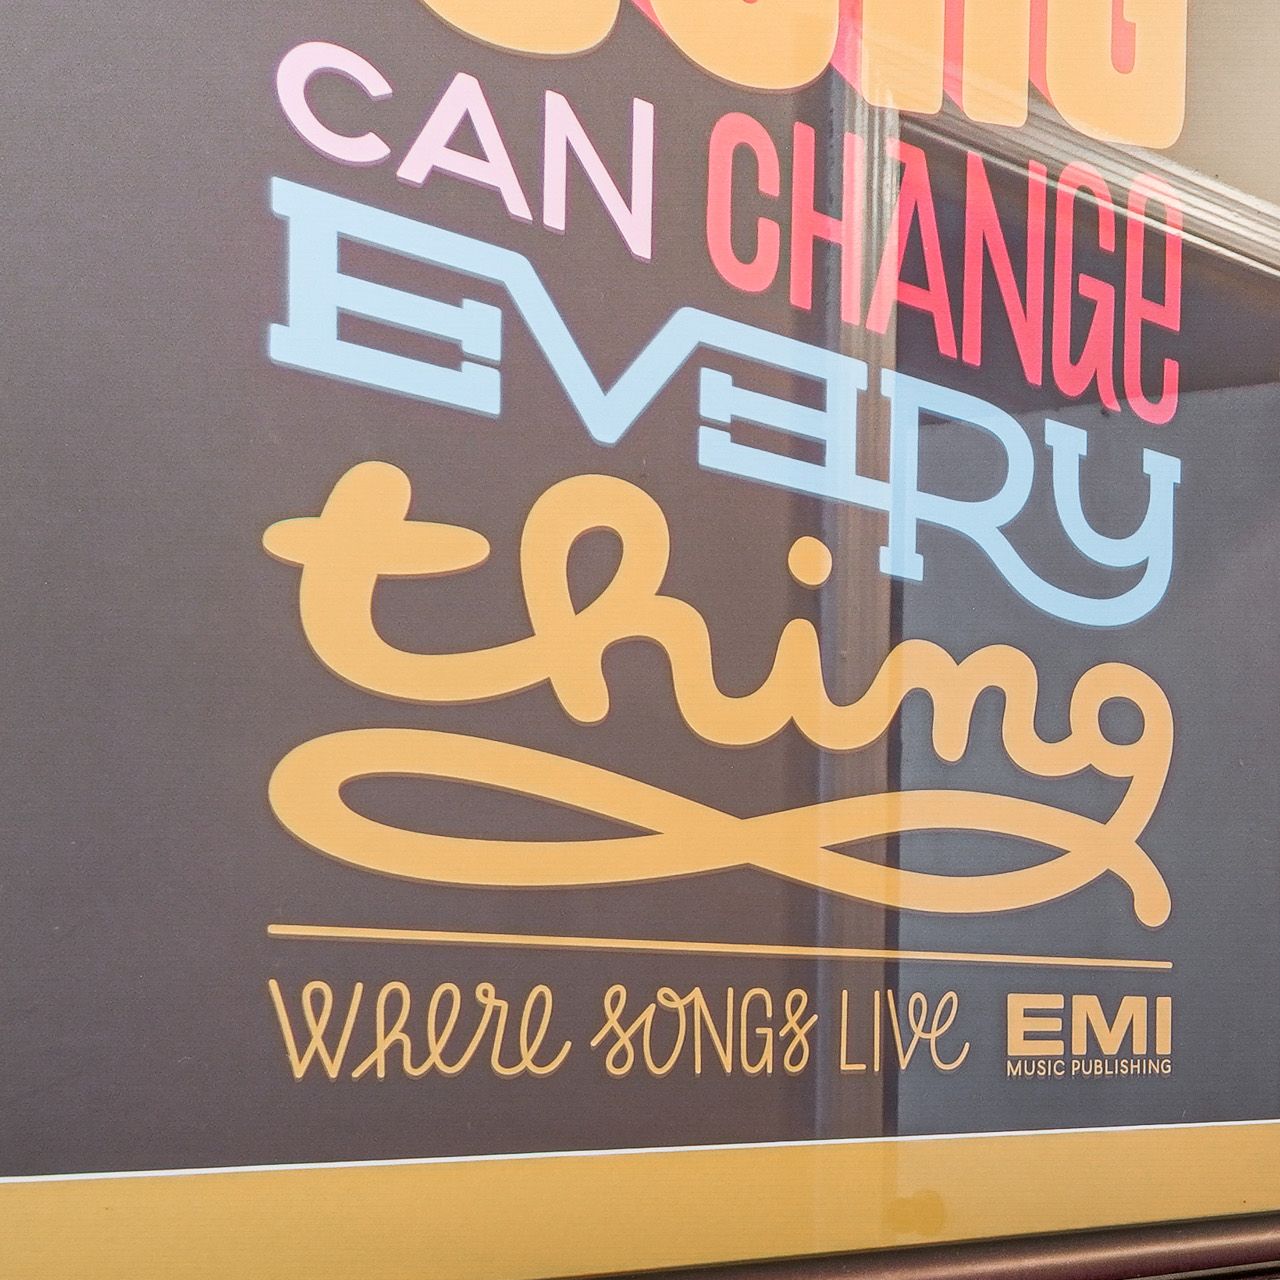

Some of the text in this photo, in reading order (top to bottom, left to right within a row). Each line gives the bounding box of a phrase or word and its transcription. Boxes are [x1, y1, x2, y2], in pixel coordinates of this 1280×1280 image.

[275, 40, 655, 260] CAN
[267, 176, 1180, 628] EVERY
[261, 459, 1173, 927] thing
[268, 978, 572, 1081] Where
[1006, 993, 1173, 1056] EMI
[1006, 1059, 1172, 1077] MUSIC PUBLISHING
